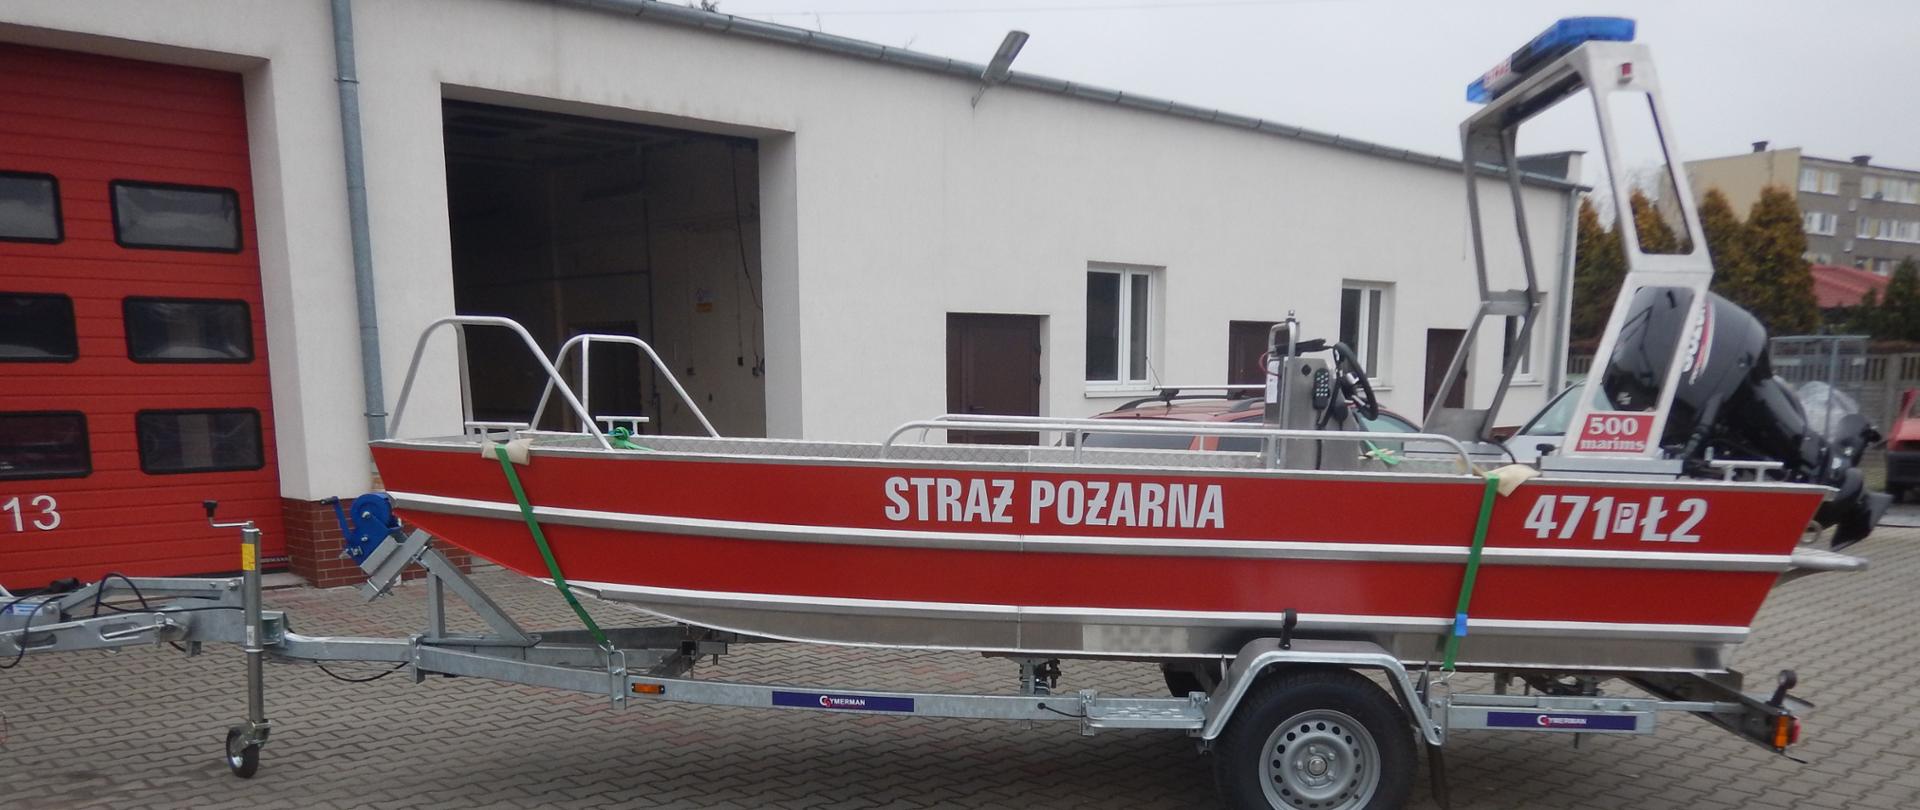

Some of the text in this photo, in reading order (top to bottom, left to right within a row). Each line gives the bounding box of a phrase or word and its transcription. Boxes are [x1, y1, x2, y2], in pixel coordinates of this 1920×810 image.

[1588, 416, 1639, 436] 500
[2, 494, 61, 532] 13
[884, 476, 1225, 529] STRAŻ POŻARNA
